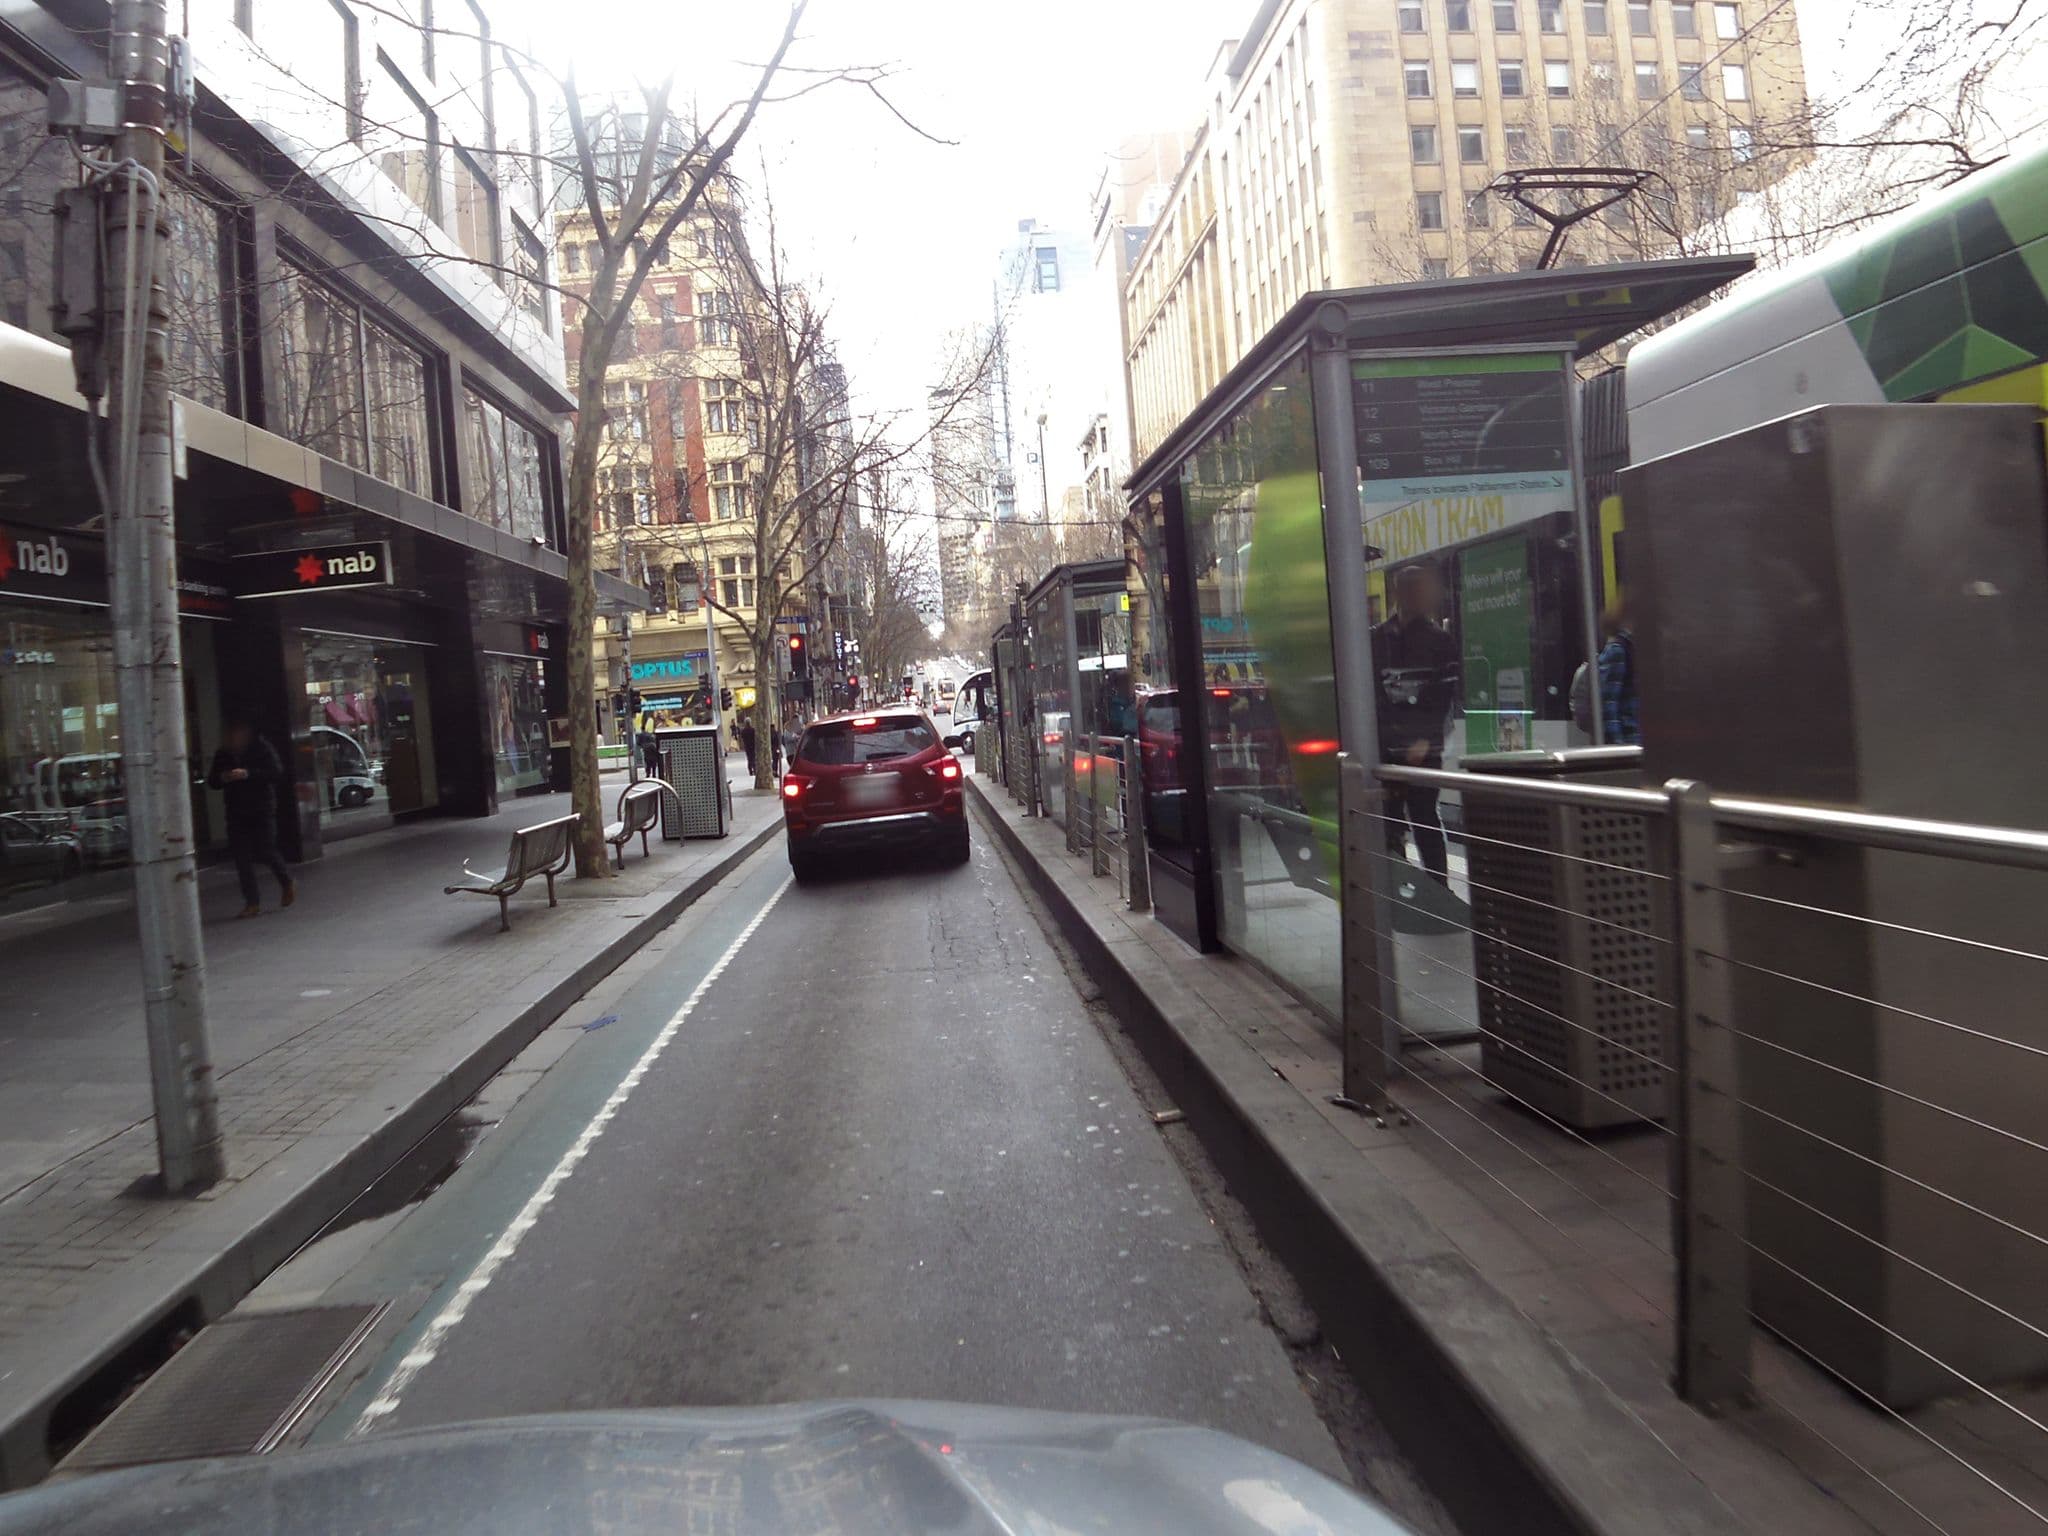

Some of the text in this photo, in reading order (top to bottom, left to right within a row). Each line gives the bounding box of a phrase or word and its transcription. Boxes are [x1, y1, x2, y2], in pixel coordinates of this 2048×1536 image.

[1364, 407, 1379, 419] 12
[1432, 495, 1504, 545] TRAM
[16, 536, 69, 576] nab
[327, 551, 377, 575] nab
[834, 631, 843, 671] NOVOTL
[631, 660, 692, 680] OPTUS
